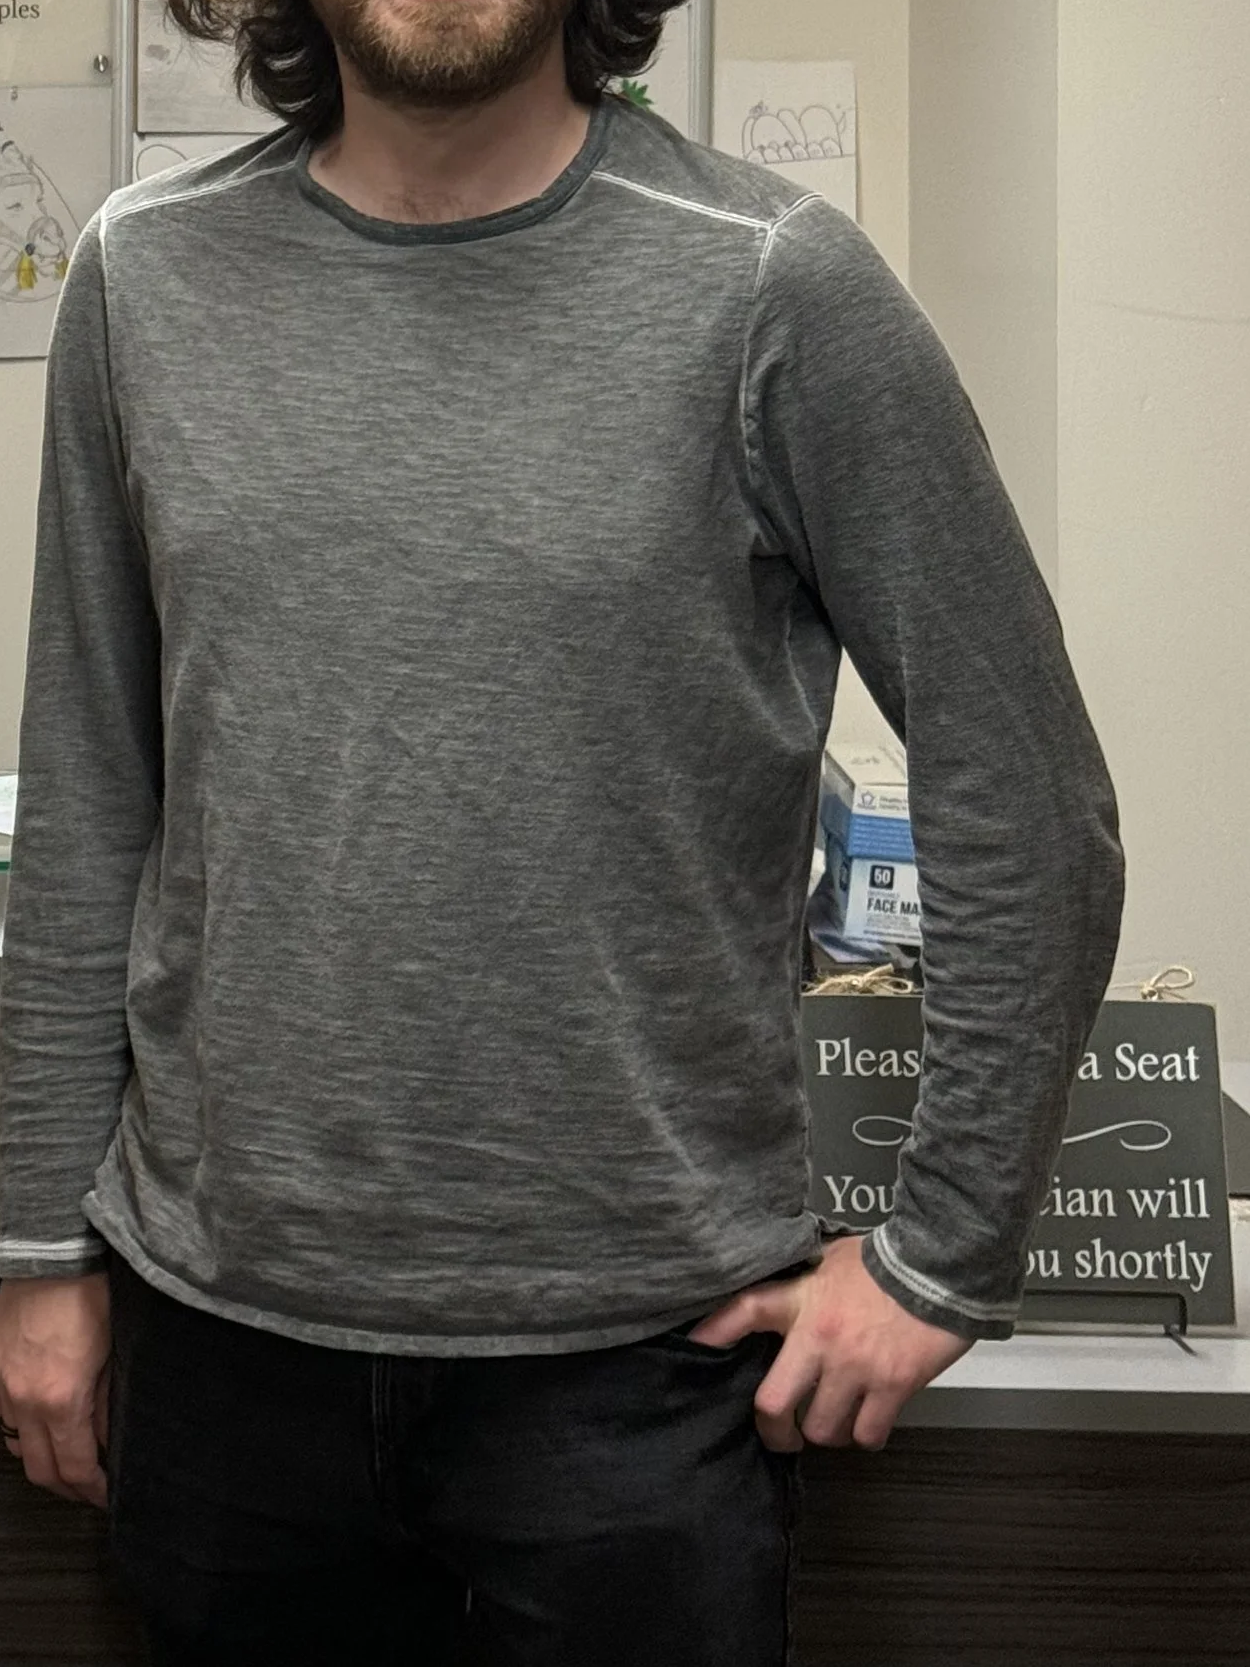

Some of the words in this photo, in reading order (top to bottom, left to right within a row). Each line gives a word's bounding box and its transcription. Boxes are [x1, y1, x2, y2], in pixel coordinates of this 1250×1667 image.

[867, 897, 898, 914] FACE
[900, 901, 921, 915] MA
[815, 1036, 921, 1078] Pleas
[1078, 1052, 1102, 1080] a
[1115, 1042, 1200, 1081] Seat
[823, 1175, 895, 1213] You
[1040, 1176, 1117, 1217] ian
[1126, 1177, 1211, 1218] will
[1074, 1238, 1212, 1292] shortly
